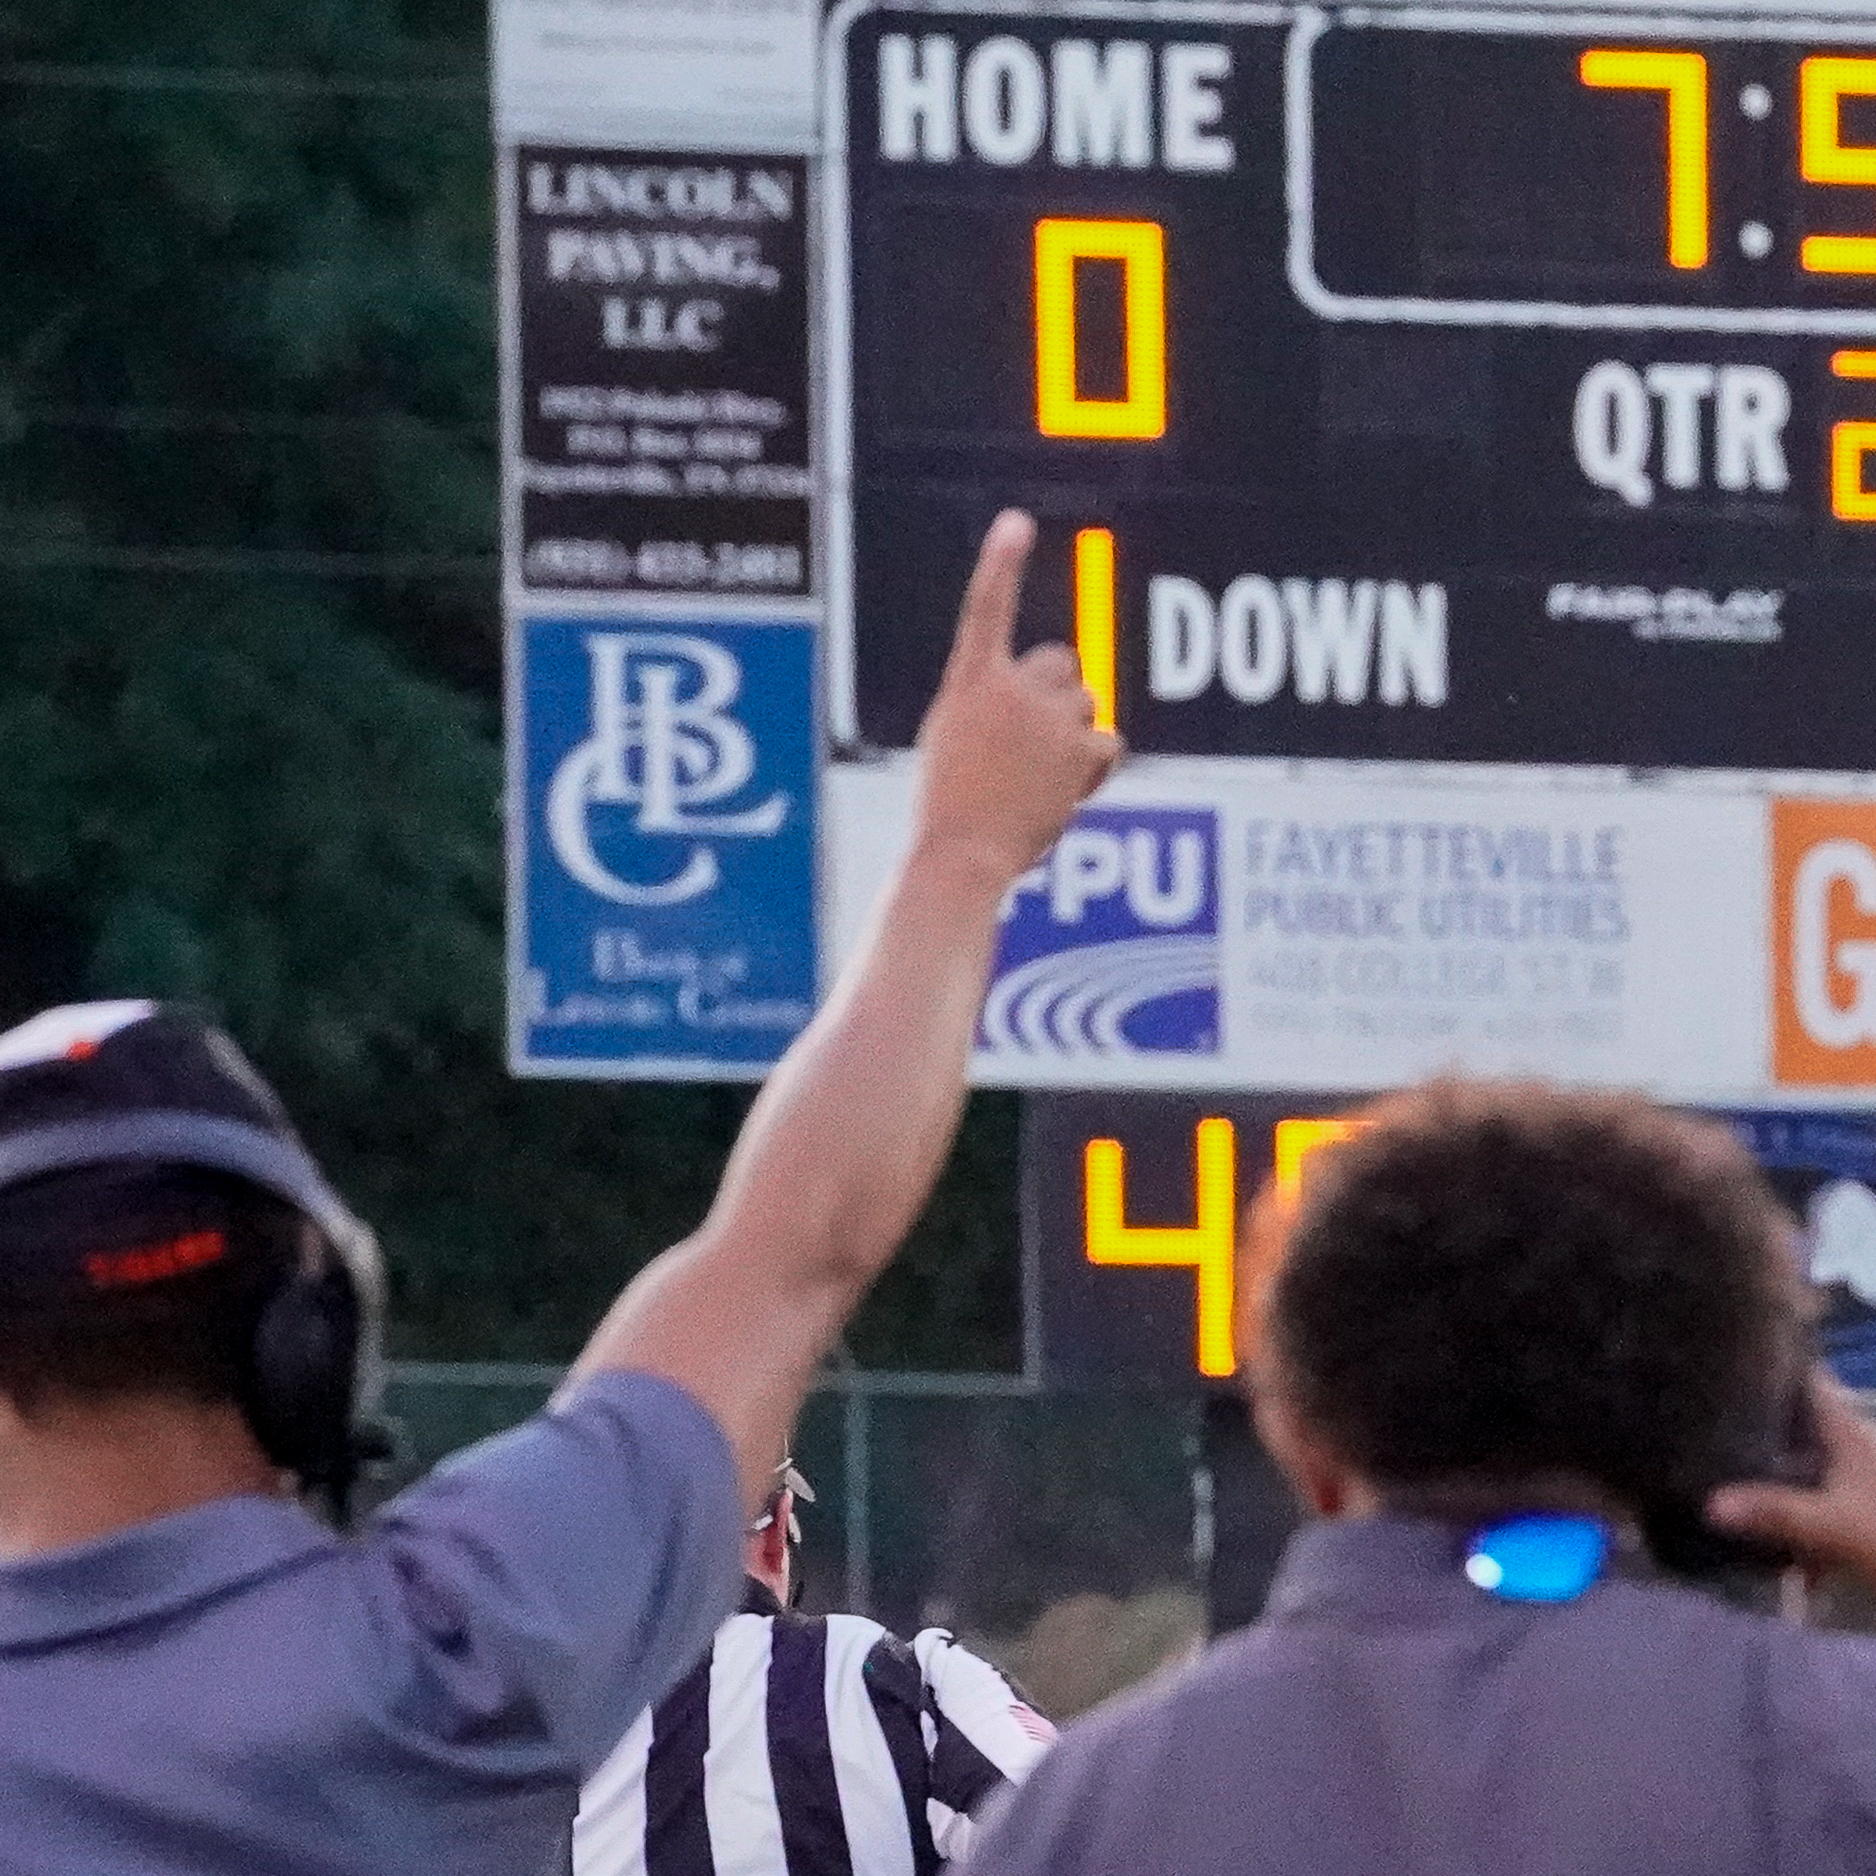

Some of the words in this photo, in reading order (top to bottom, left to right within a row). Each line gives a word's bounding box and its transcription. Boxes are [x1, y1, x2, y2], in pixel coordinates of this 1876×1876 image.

[878, 33, 1236, 172] HOME
[527, 161, 793, 222] LINCOLN
[602, 298, 725, 352] LLC
[1034, 218, 1166, 440] 0
[1572, 359, 1791, 508] QTR
[1144, 574, 1450, 709] DOWN
[1246, 820, 1625, 884] FAYETTEVILLE
[1243, 890, 1403, 941] PUBLIC
[1418, 892, 1631, 945] UTILITIES
